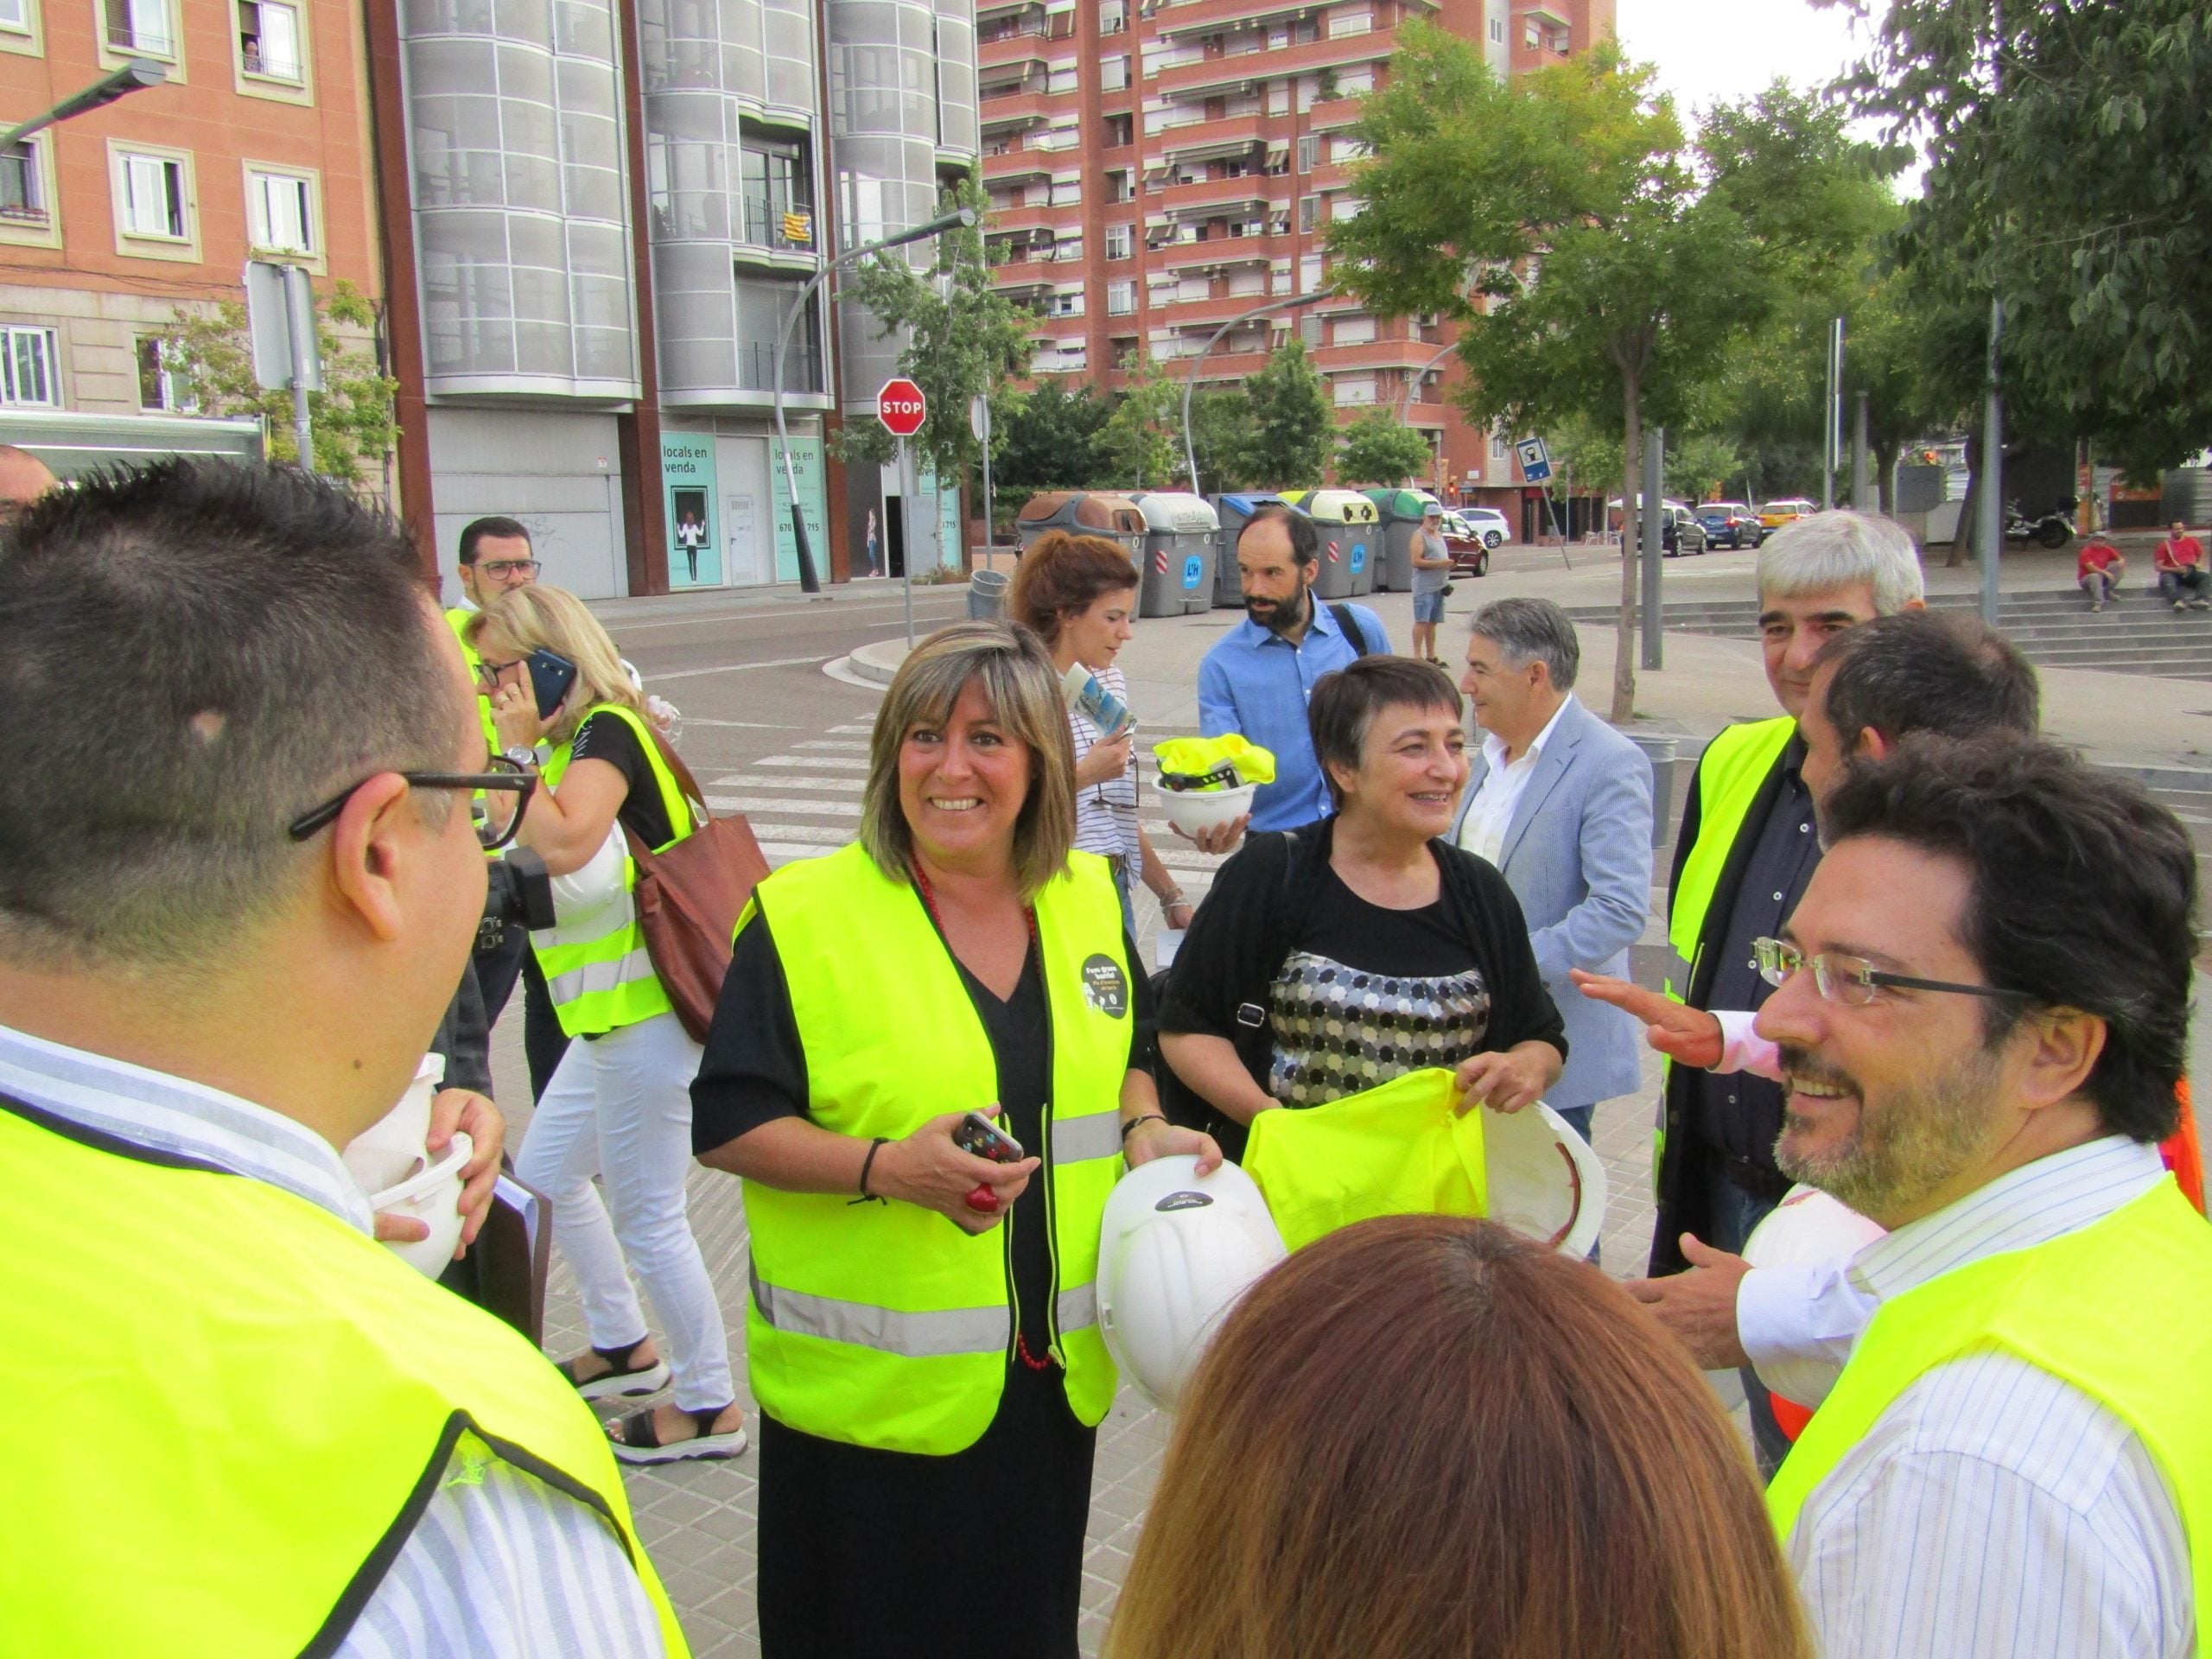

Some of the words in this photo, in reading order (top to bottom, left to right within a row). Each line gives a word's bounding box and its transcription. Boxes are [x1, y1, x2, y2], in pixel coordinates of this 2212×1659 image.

[882, 402, 922, 414] STOP
[663, 446, 692, 458] locals
[695, 448, 707, 458] en
[775, 449, 801, 461] loals
[803, 451, 814, 461] en
[664, 462, 696, 474] venda
[776, 464, 804, 474] veda
[779, 523, 792, 532] 670
[807, 523, 819, 531] 715
